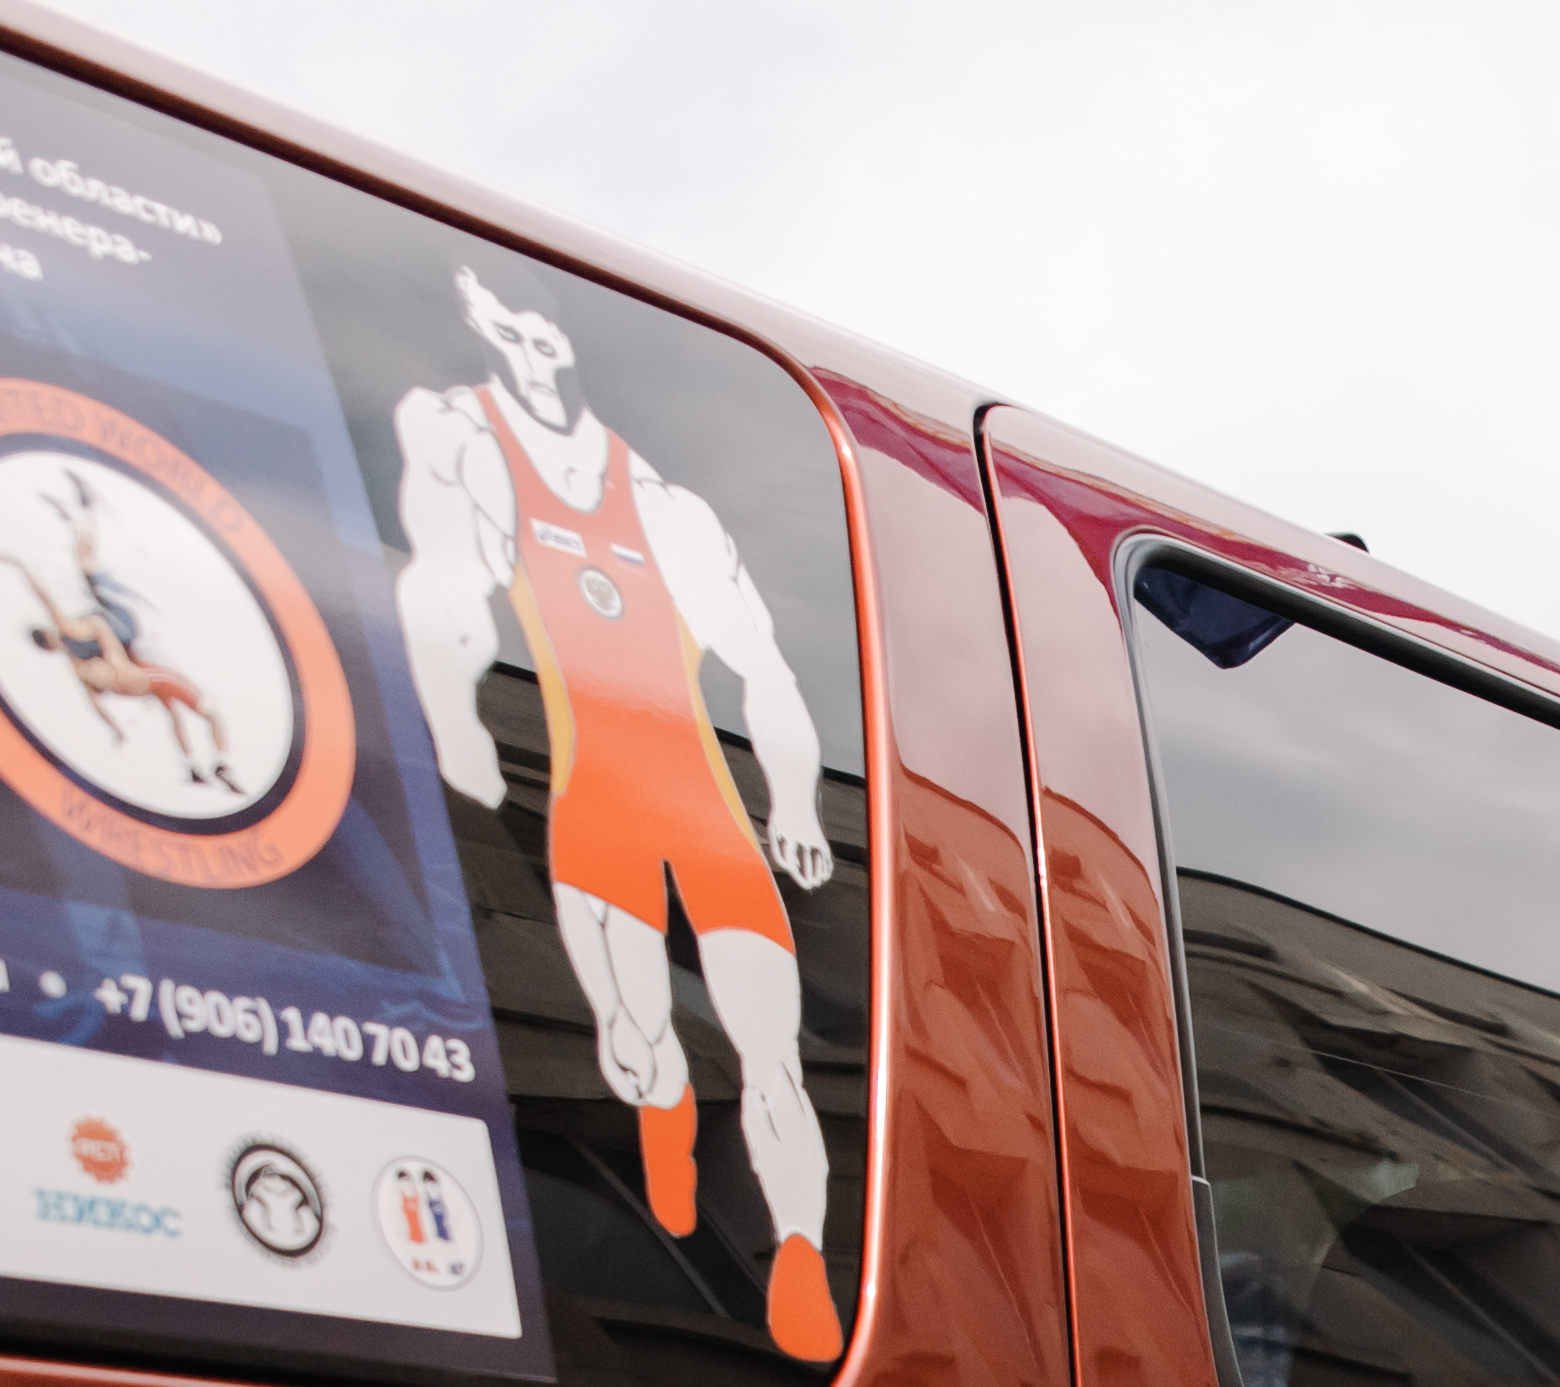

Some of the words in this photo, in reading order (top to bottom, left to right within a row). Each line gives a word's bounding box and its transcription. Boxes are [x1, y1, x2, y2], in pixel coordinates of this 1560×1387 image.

[95, 973, 153, 1022] +7
[158, 977, 279, 1057] (906)
[280, 1005, 364, 1062] 140
